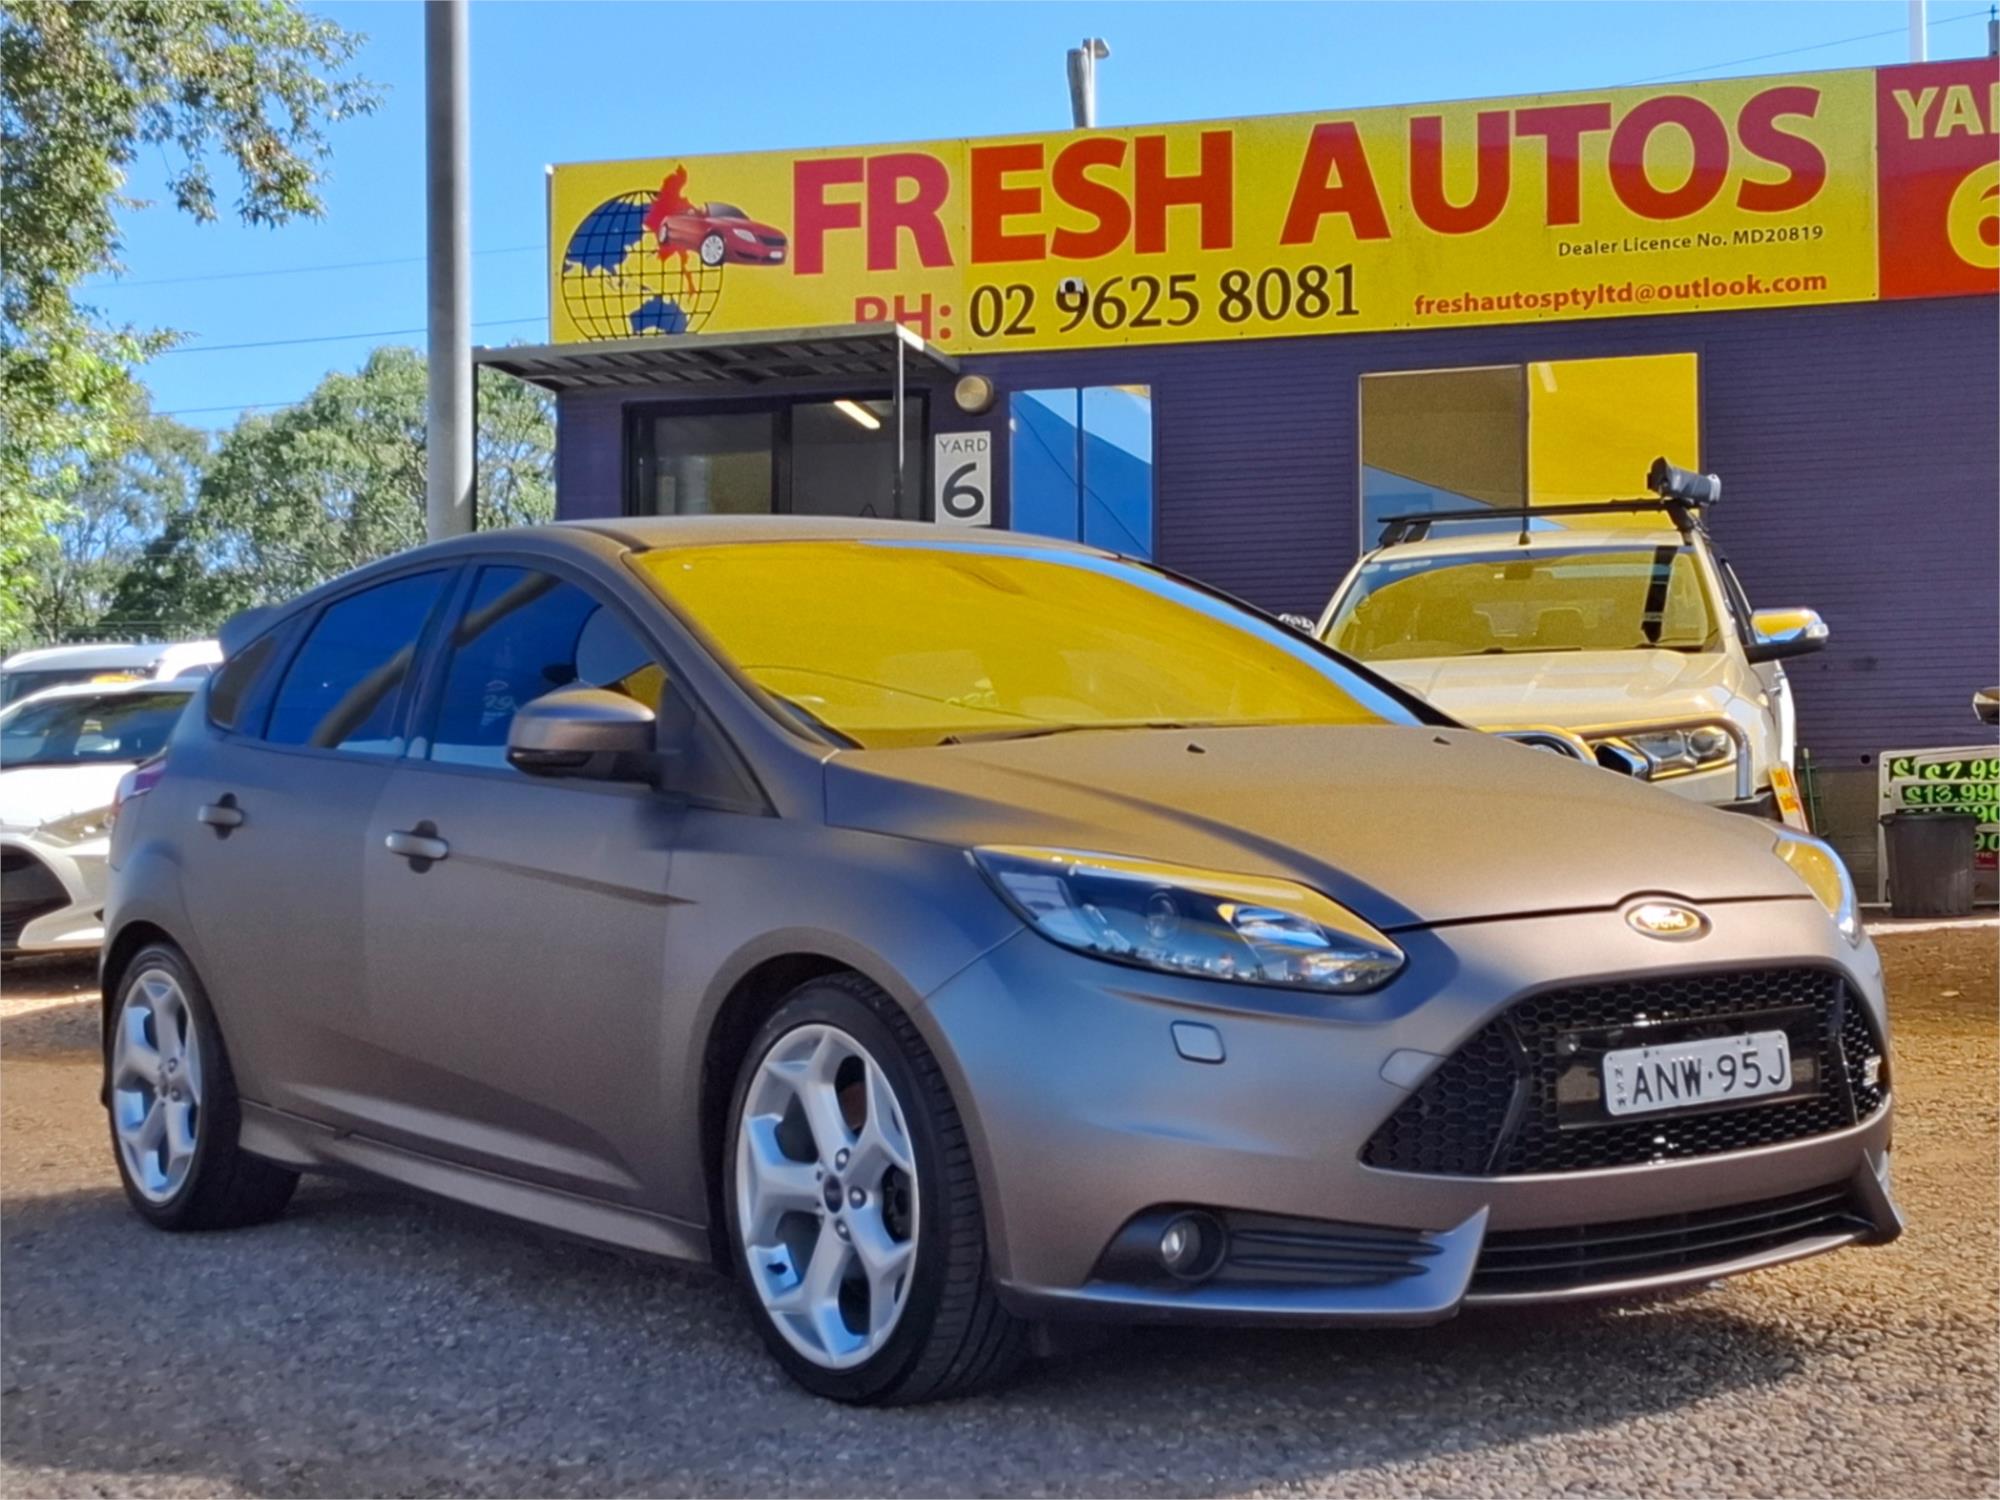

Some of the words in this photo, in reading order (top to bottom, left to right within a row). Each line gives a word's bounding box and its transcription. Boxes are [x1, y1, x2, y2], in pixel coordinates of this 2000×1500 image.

[1892, 82, 1999, 139] YA
[794, 131, 1233, 274] FRESH
[1279, 86, 1827, 244] AUTOS
[1558, 240, 1617, 256] Dealer
[1623, 237, 1691, 252] Licence
[1697, 233, 1728, 249] No.
[1733, 226, 1824, 245] MD20819
[854, 292, 952, 340] PH:
[970, 284, 1036, 337] 02
[1055, 274, 1200, 333] 9625
[1218, 263, 1360, 323] 8081
[1414, 274, 1827, 315] freshautosptyltd@outlook.com
[939, 438, 988, 454] YARD
[942, 462, 985, 519] 6
